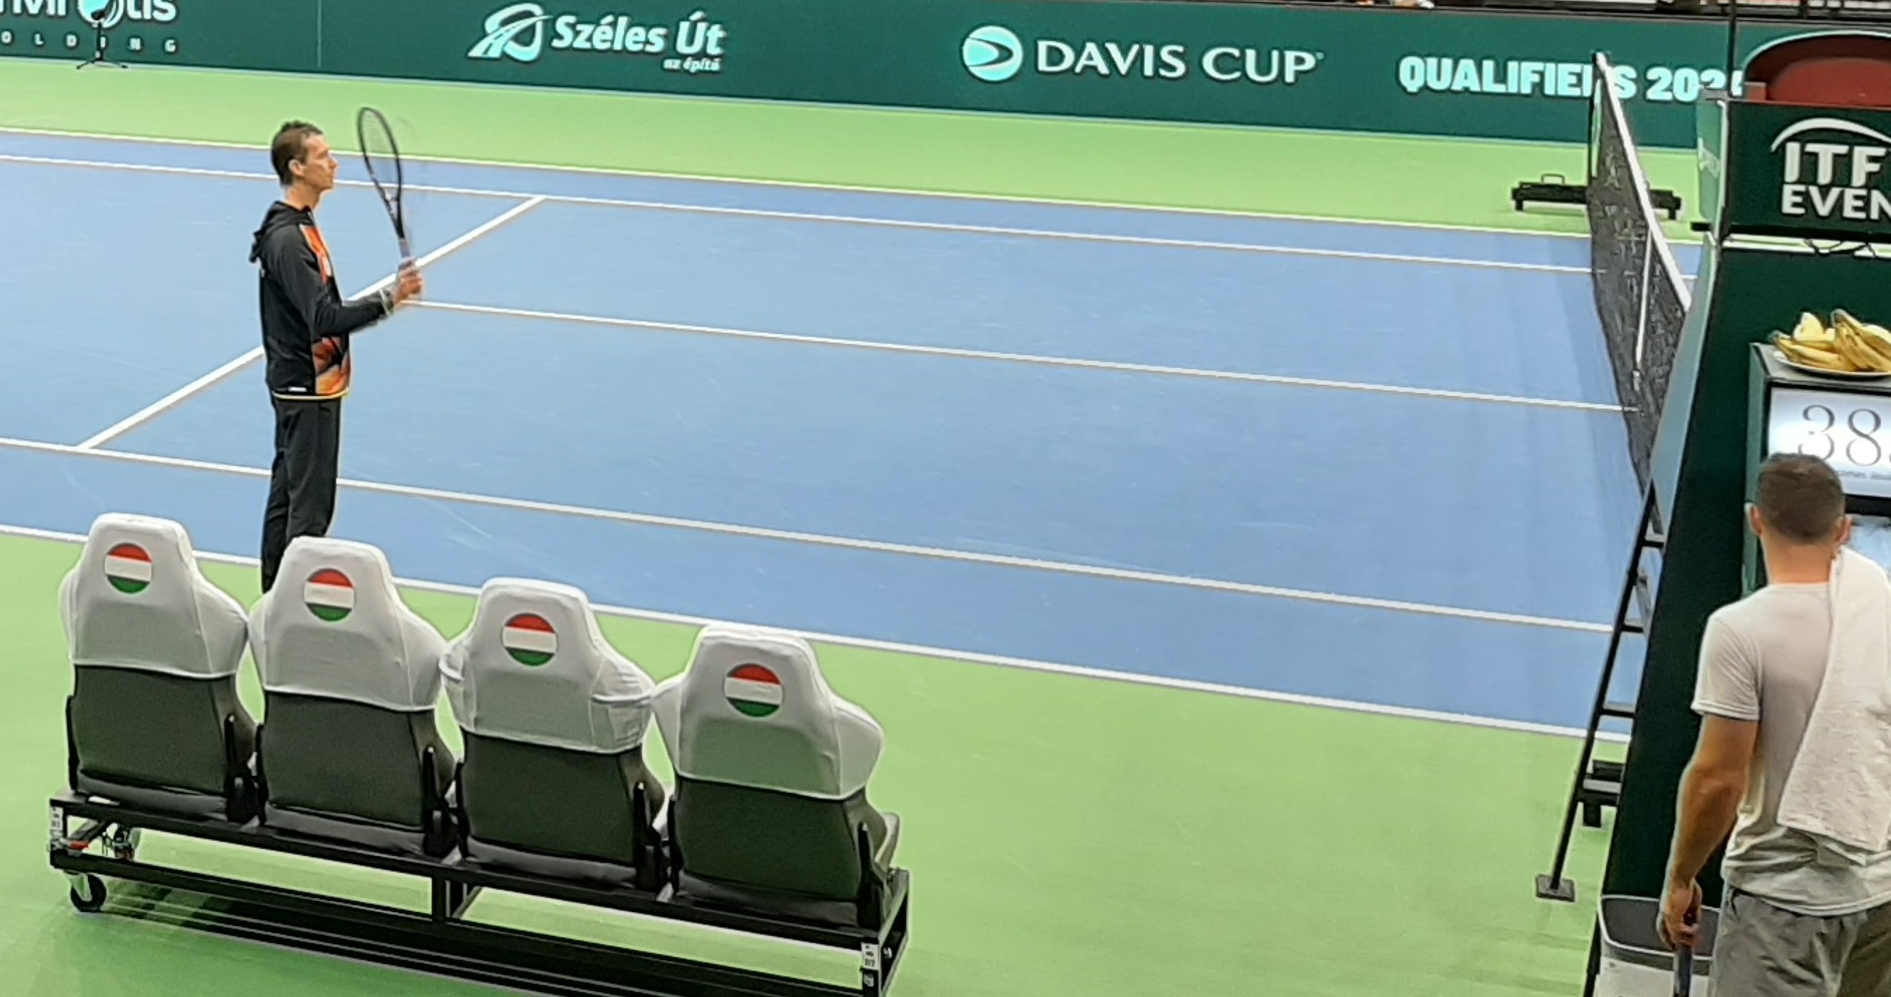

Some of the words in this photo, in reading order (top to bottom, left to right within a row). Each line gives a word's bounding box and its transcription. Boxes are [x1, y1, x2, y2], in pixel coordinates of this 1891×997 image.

[551, 14, 668, 53] Széles
[675, 0, 727, 56] Út
[1036, 39, 1187, 78] DAVIS
[1784, 142, 1887, 187] ITF
